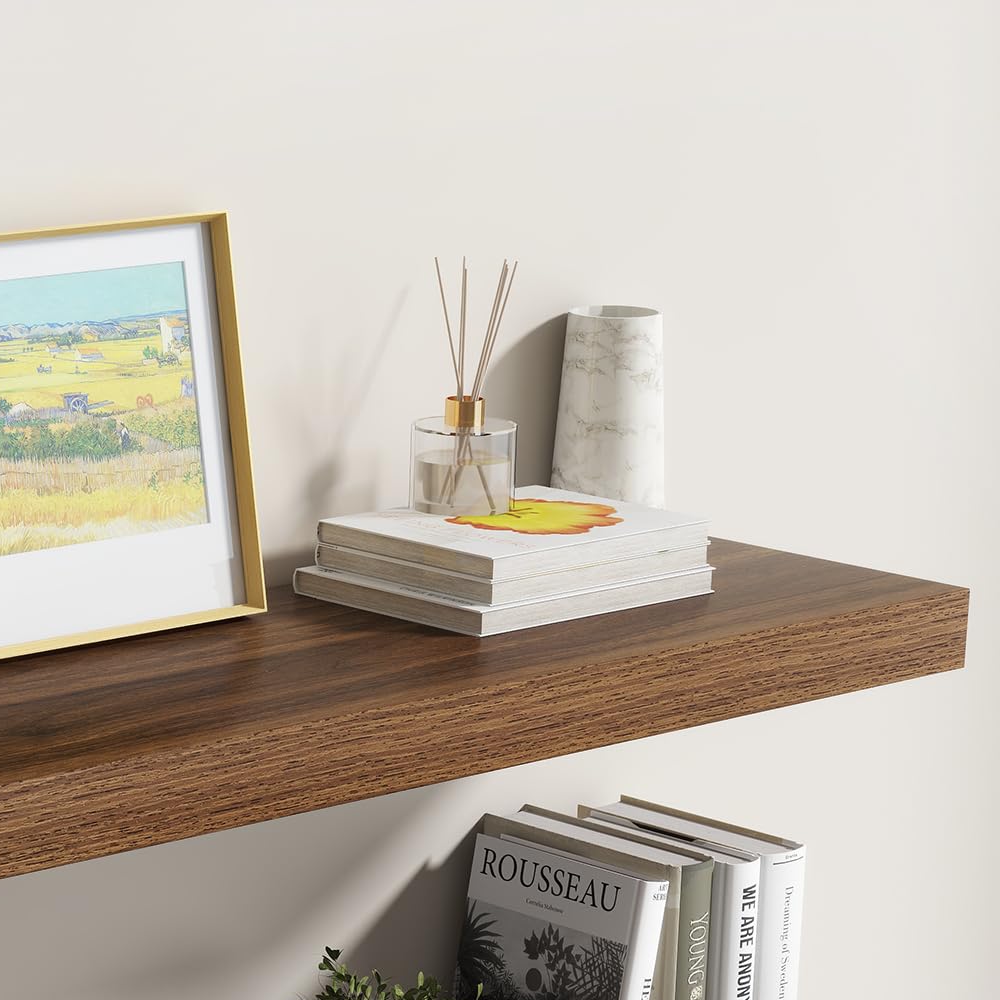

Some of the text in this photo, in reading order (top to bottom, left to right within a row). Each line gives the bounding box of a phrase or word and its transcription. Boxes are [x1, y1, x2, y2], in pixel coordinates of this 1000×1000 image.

[480, 847, 622, 912] ROUSSEAU
[741, 884, 757, 912] WE
[688, 912, 709, 985] YOUNG
[740, 916, 755, 949] ARE
[778, 886, 794, 1000] Dreaming of Sweden
